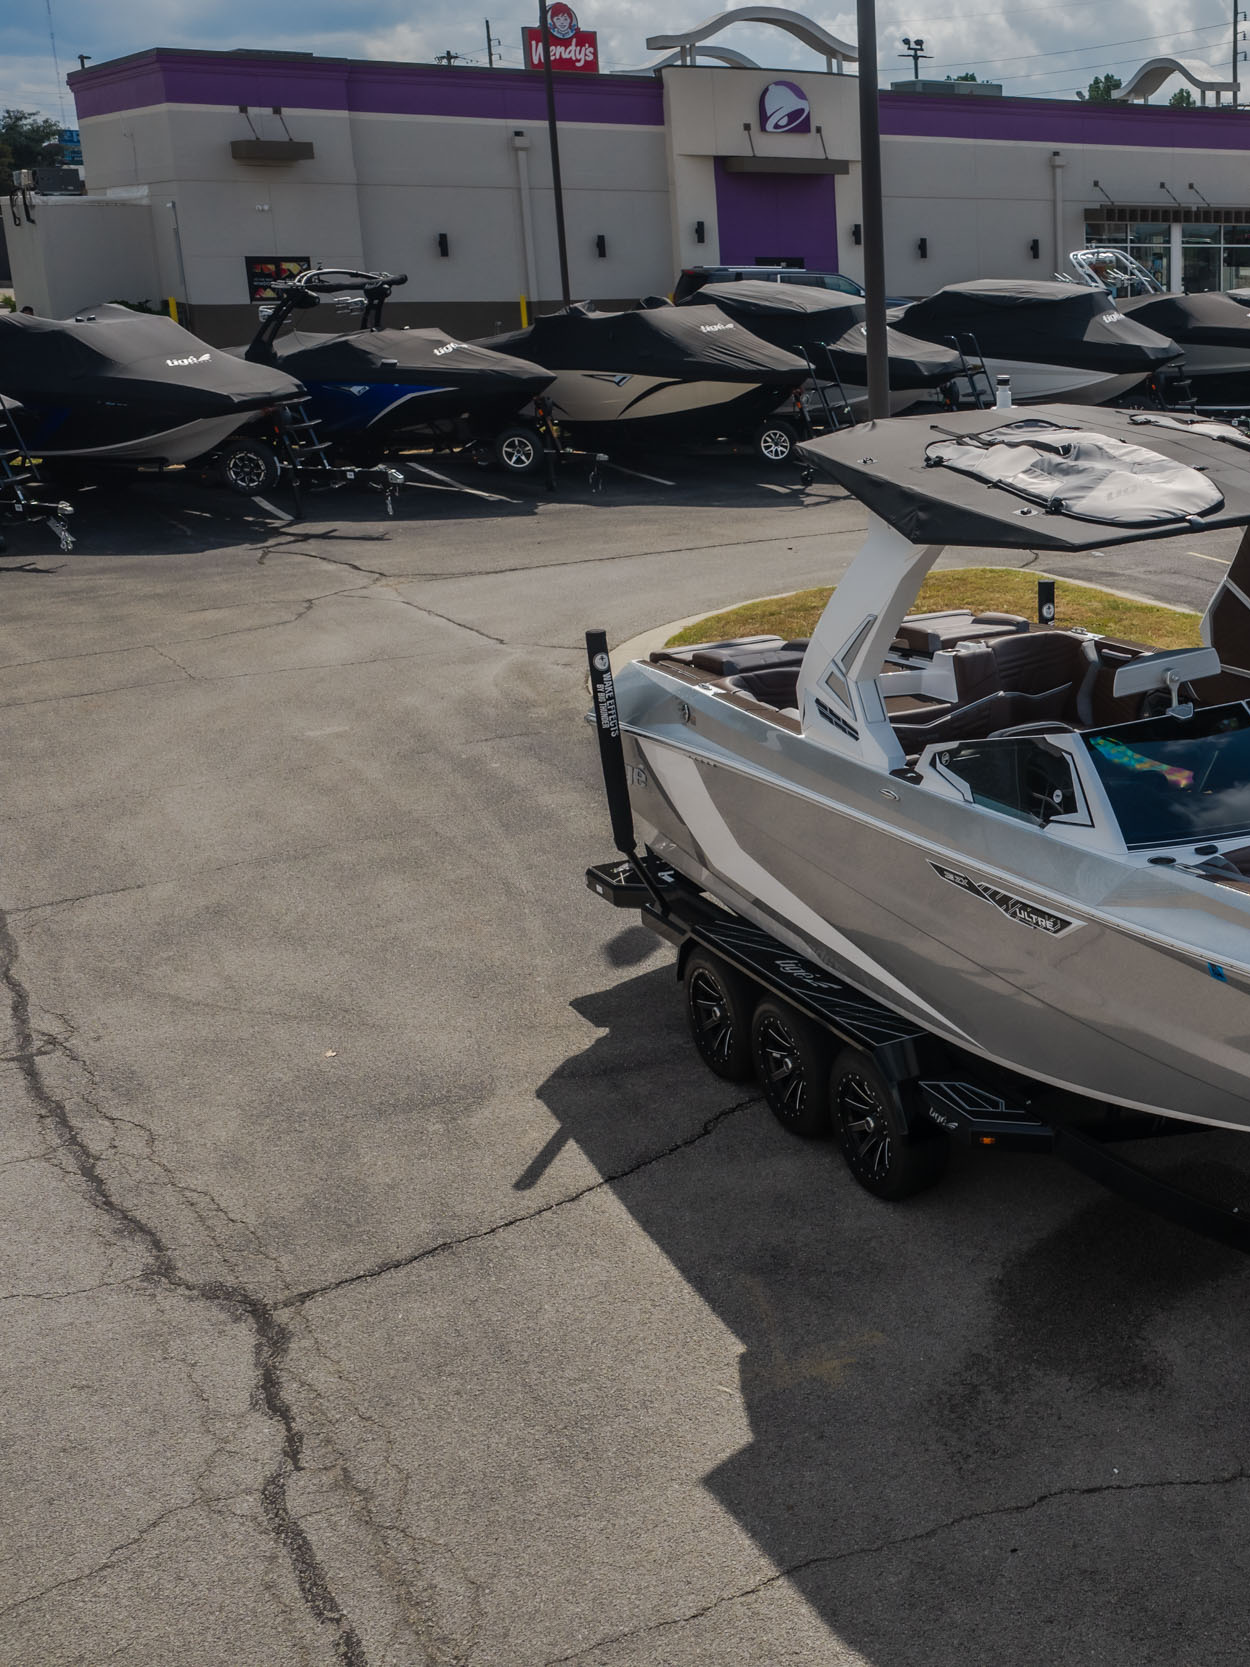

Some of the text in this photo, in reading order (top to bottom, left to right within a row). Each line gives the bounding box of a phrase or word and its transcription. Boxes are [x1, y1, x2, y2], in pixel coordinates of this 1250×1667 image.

[531, 38, 594, 67] Wendy's
[599, 702, 610, 729] THUNDER
[602, 671, 619, 738] WAKE EFFECTS
